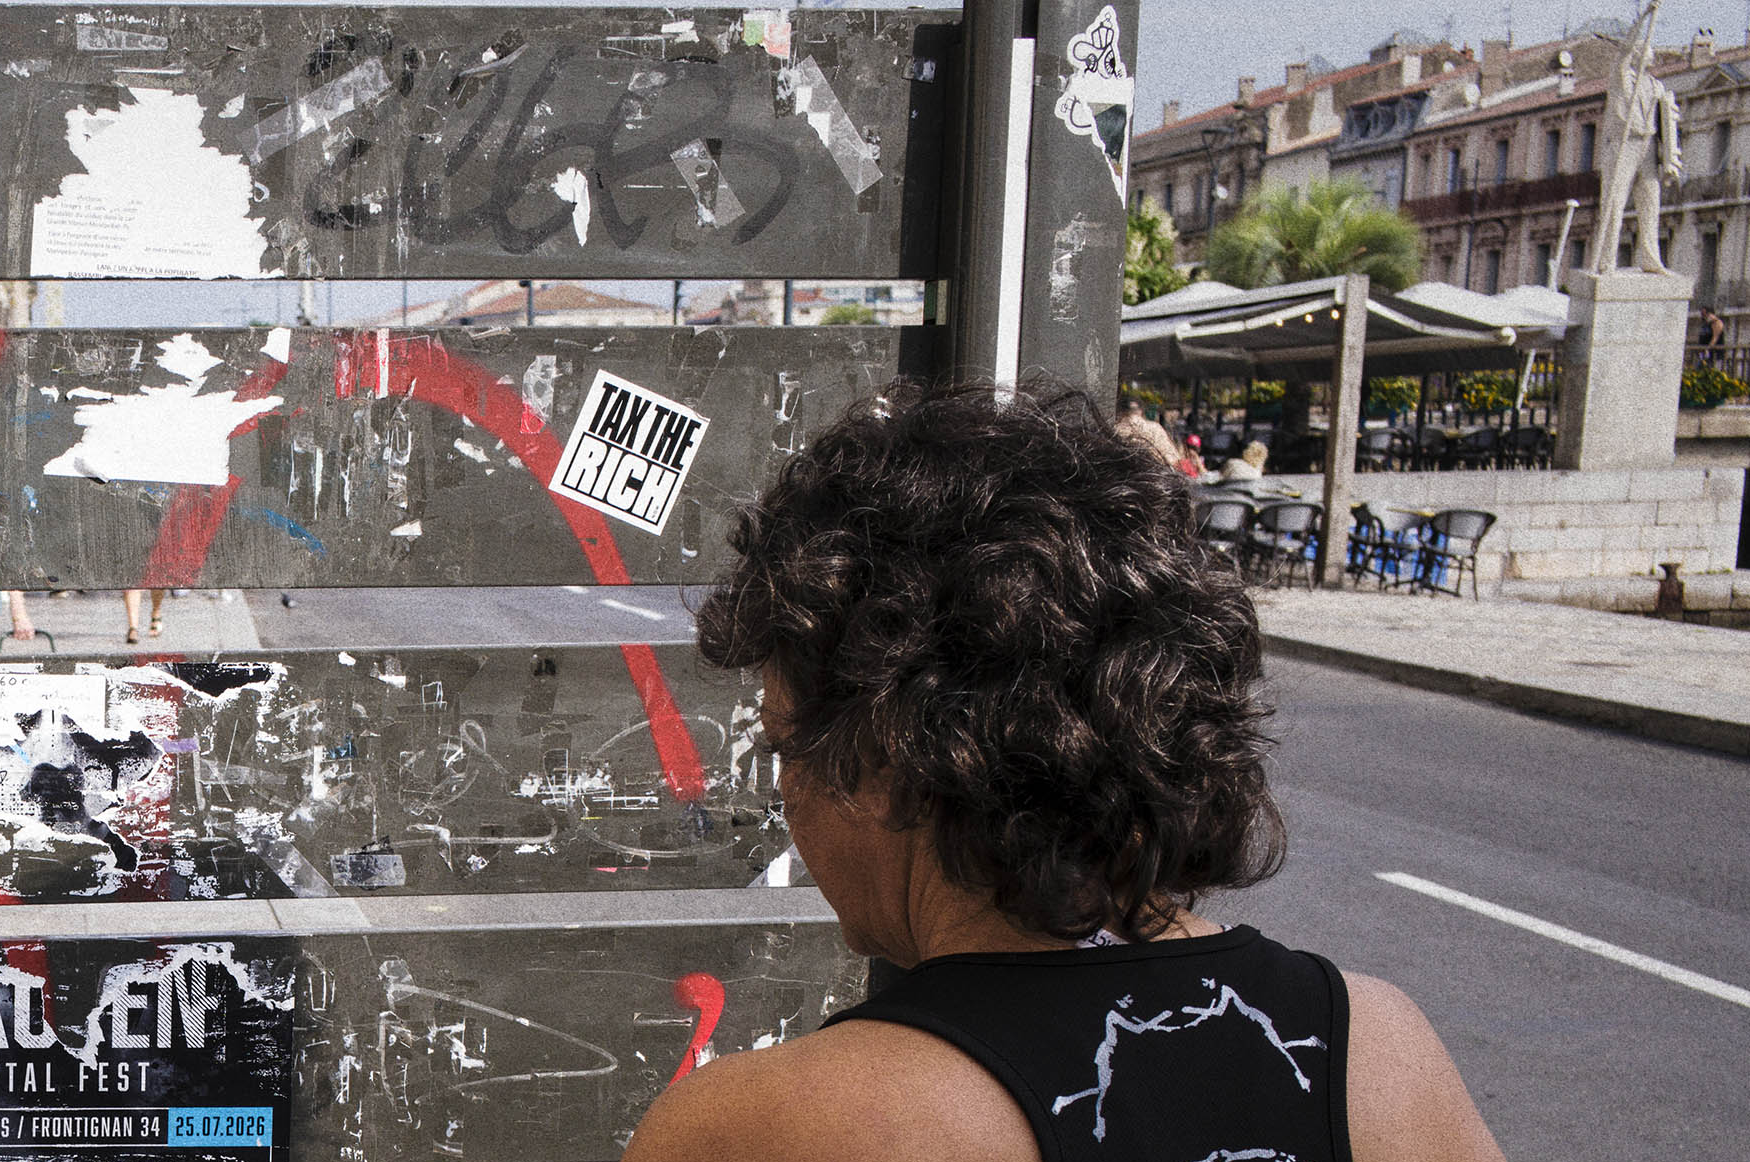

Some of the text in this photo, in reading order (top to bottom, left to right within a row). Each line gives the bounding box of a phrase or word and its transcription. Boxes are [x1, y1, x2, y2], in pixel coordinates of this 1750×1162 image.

[588, 381, 702, 471] TAX THE
[562, 434, 680, 525] RICH
[79, 1060, 151, 1092] FEST
[31, 1115, 134, 1138] FRONTIGNAN
[140, 1115, 161, 1137] 34
[175, 1115, 266, 1137] 25.07.2026
